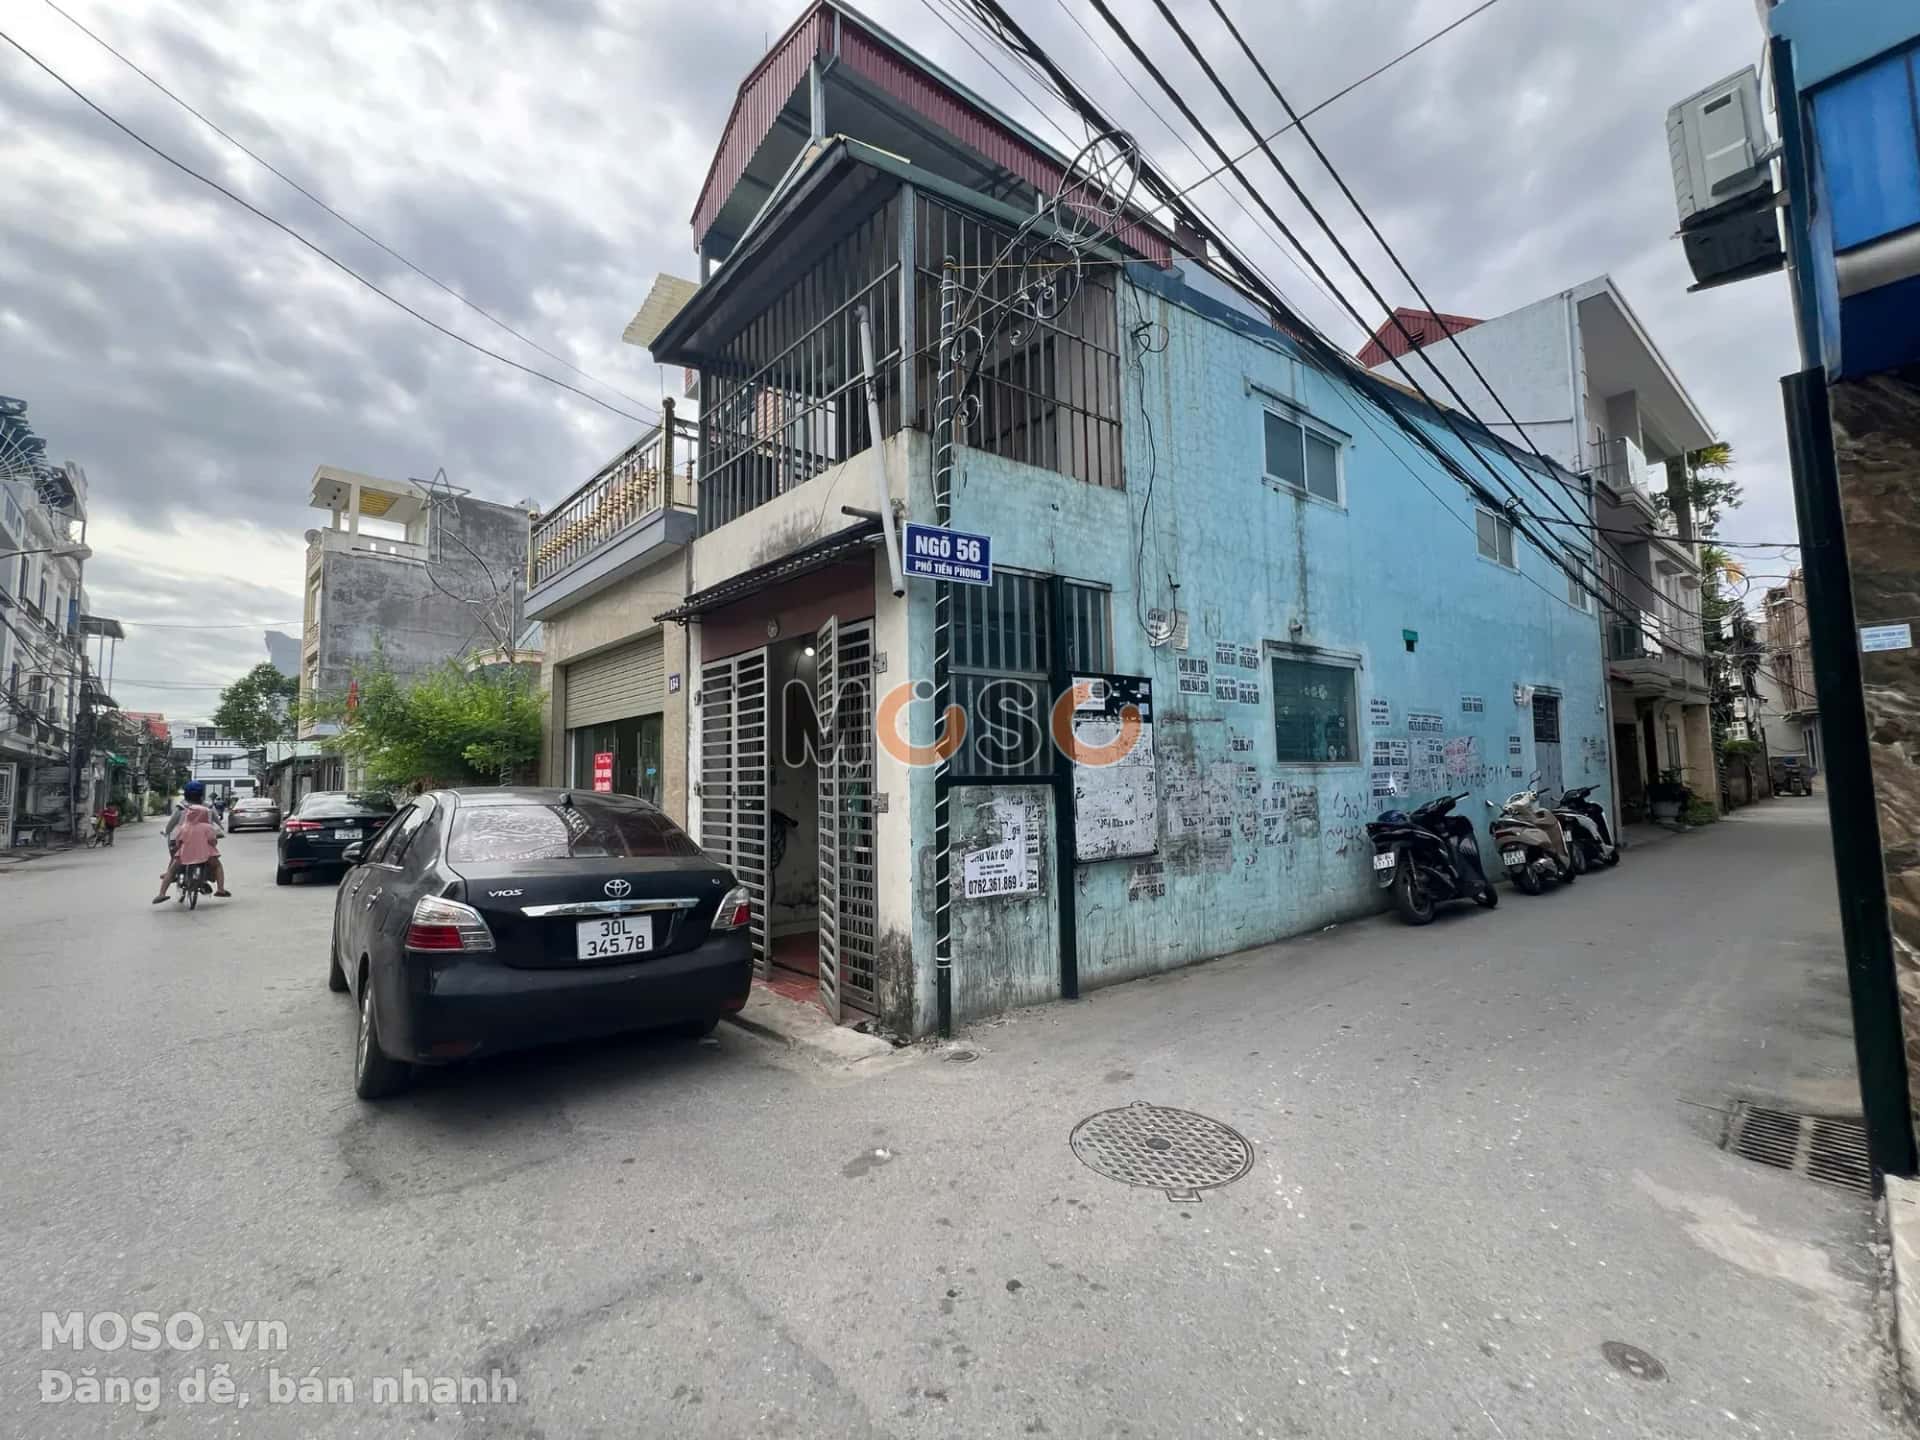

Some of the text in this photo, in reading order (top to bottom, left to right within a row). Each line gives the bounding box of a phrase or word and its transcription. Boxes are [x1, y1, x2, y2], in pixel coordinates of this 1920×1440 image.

[915, 535, 981, 563] NGÕ 56
[915, 559, 932, 573] PHỐ
[954, 566, 982, 579] PHONG
[985, 850, 999, 862] VAY
[488, 888, 525, 898] VIOS
[600, 919, 632, 937] 30L
[587, 935, 645, 956] 345.78
